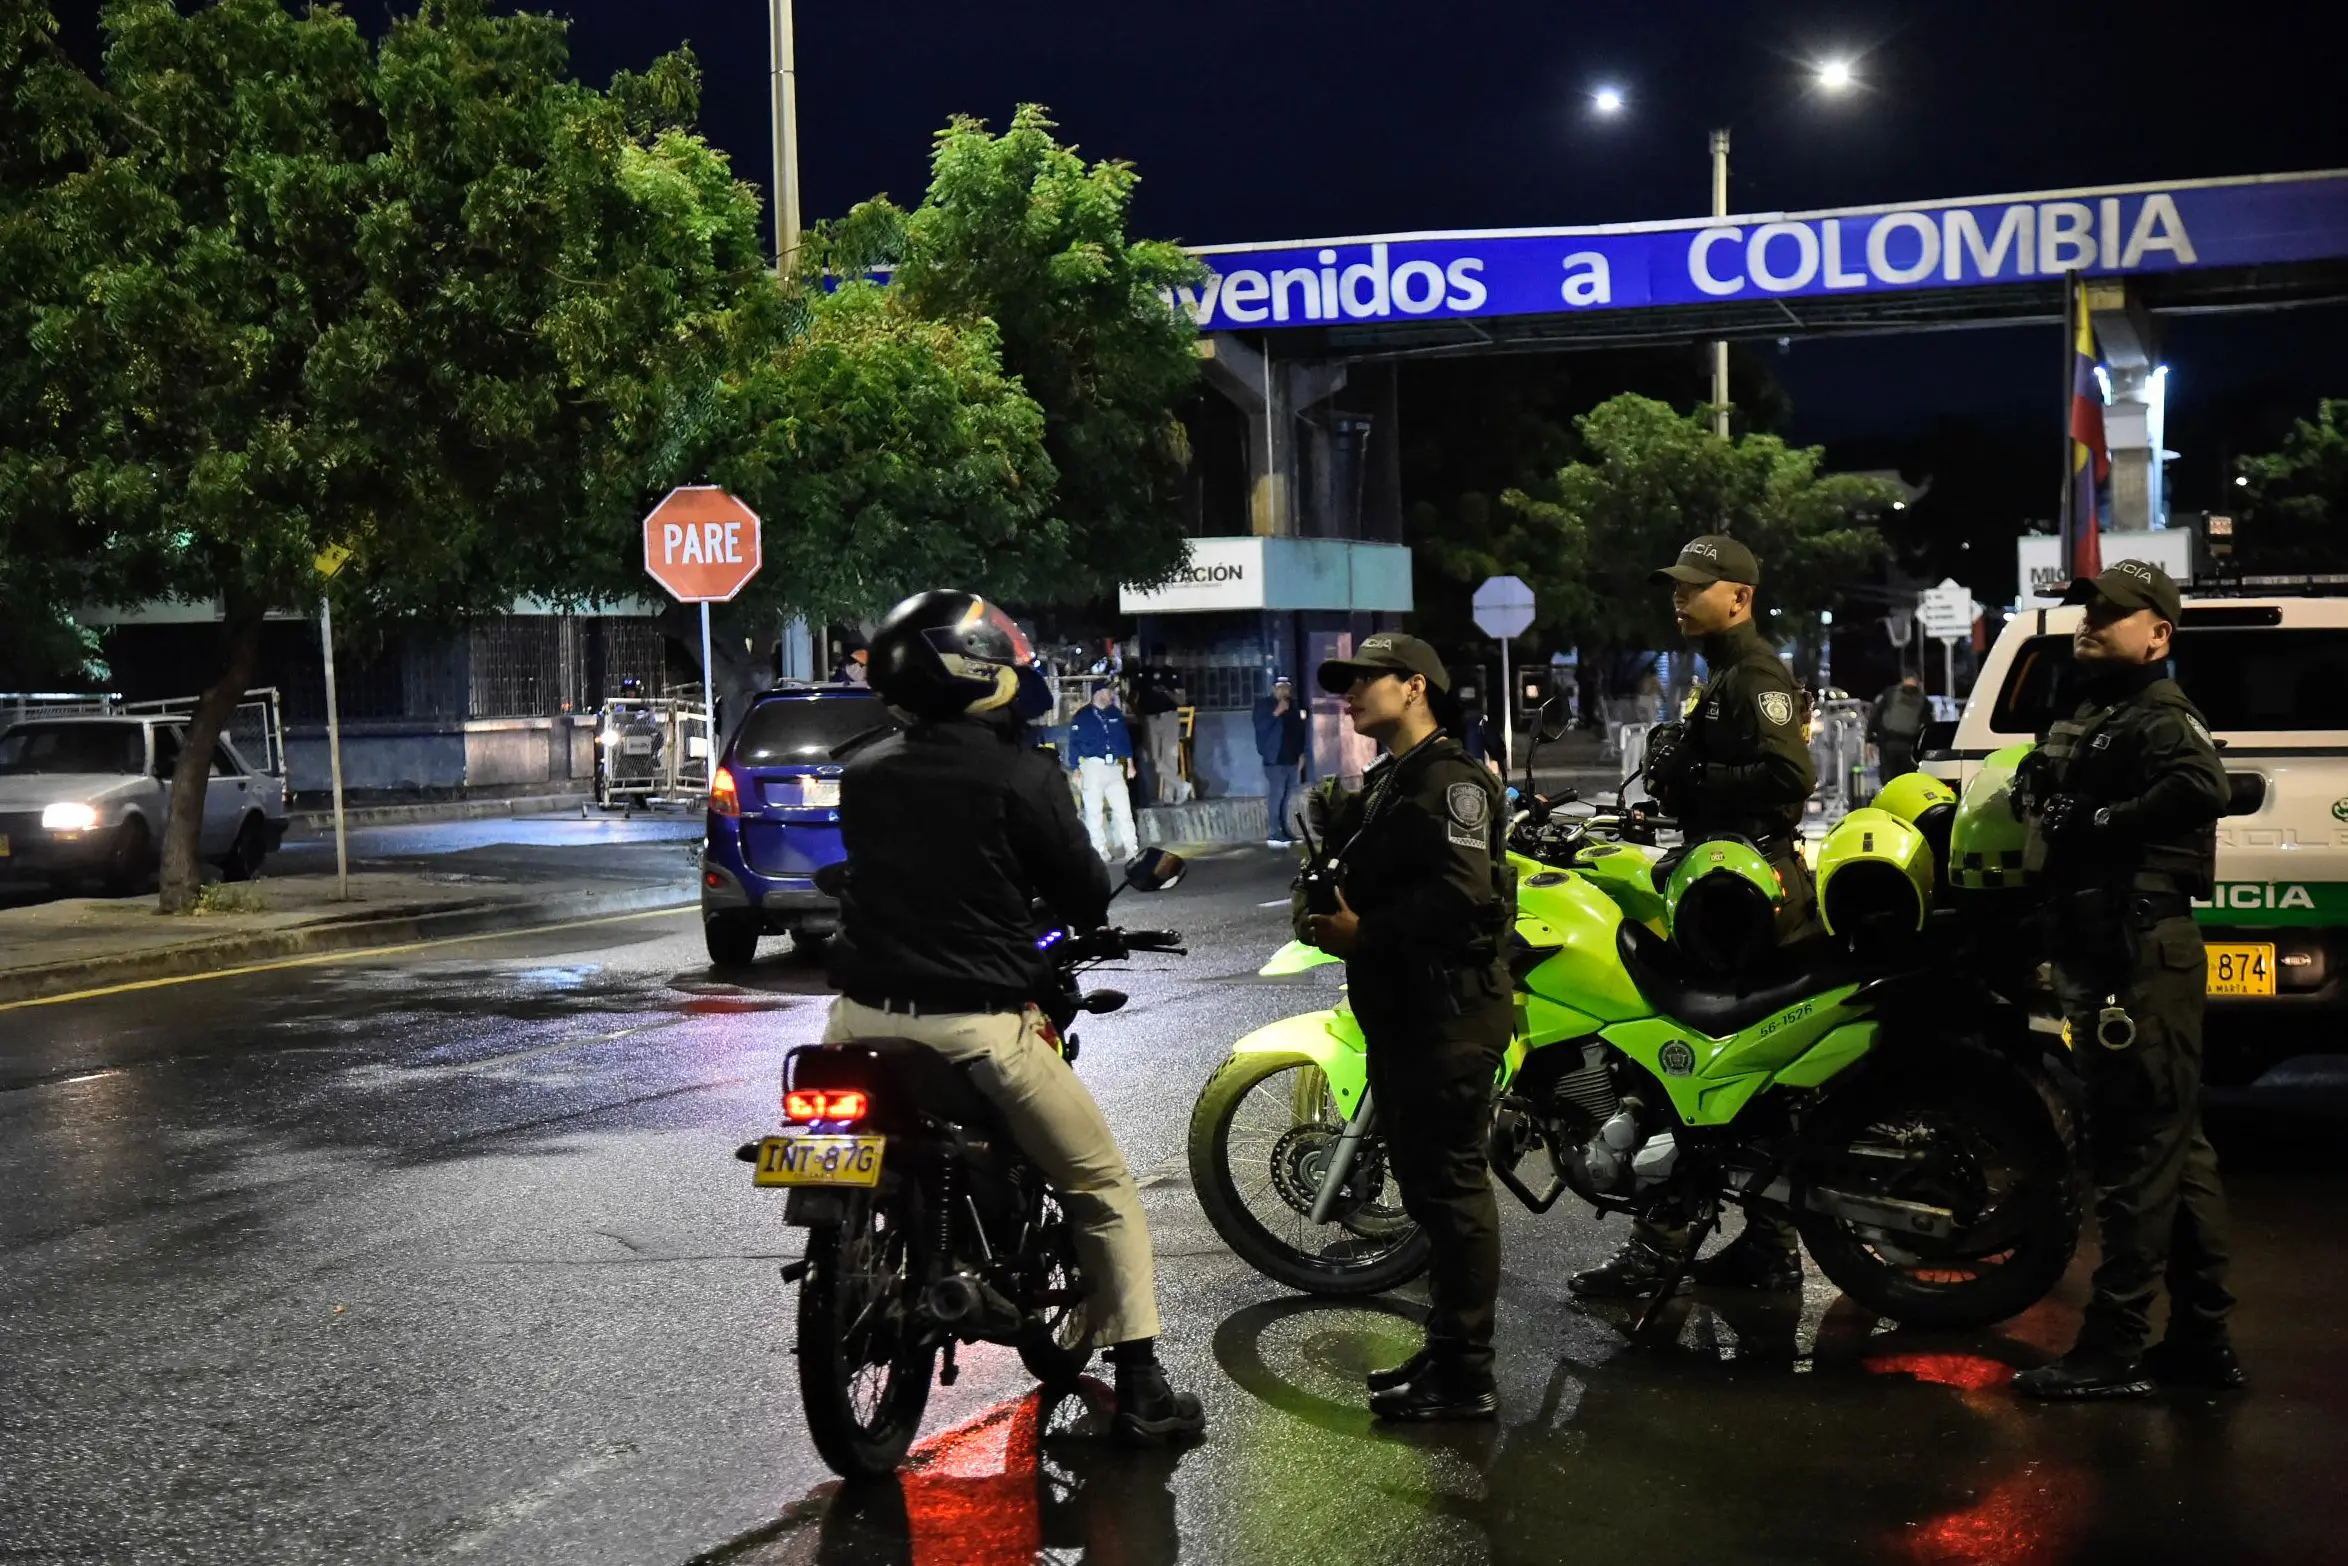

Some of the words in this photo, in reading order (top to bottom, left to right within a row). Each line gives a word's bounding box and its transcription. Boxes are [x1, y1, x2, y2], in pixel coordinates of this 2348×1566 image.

[1561, 251, 1611, 306] a
[1688, 194, 2197, 295] COLOMBIA
[663, 521, 743, 565] PARE
[2218, 953, 2267, 982] 874
